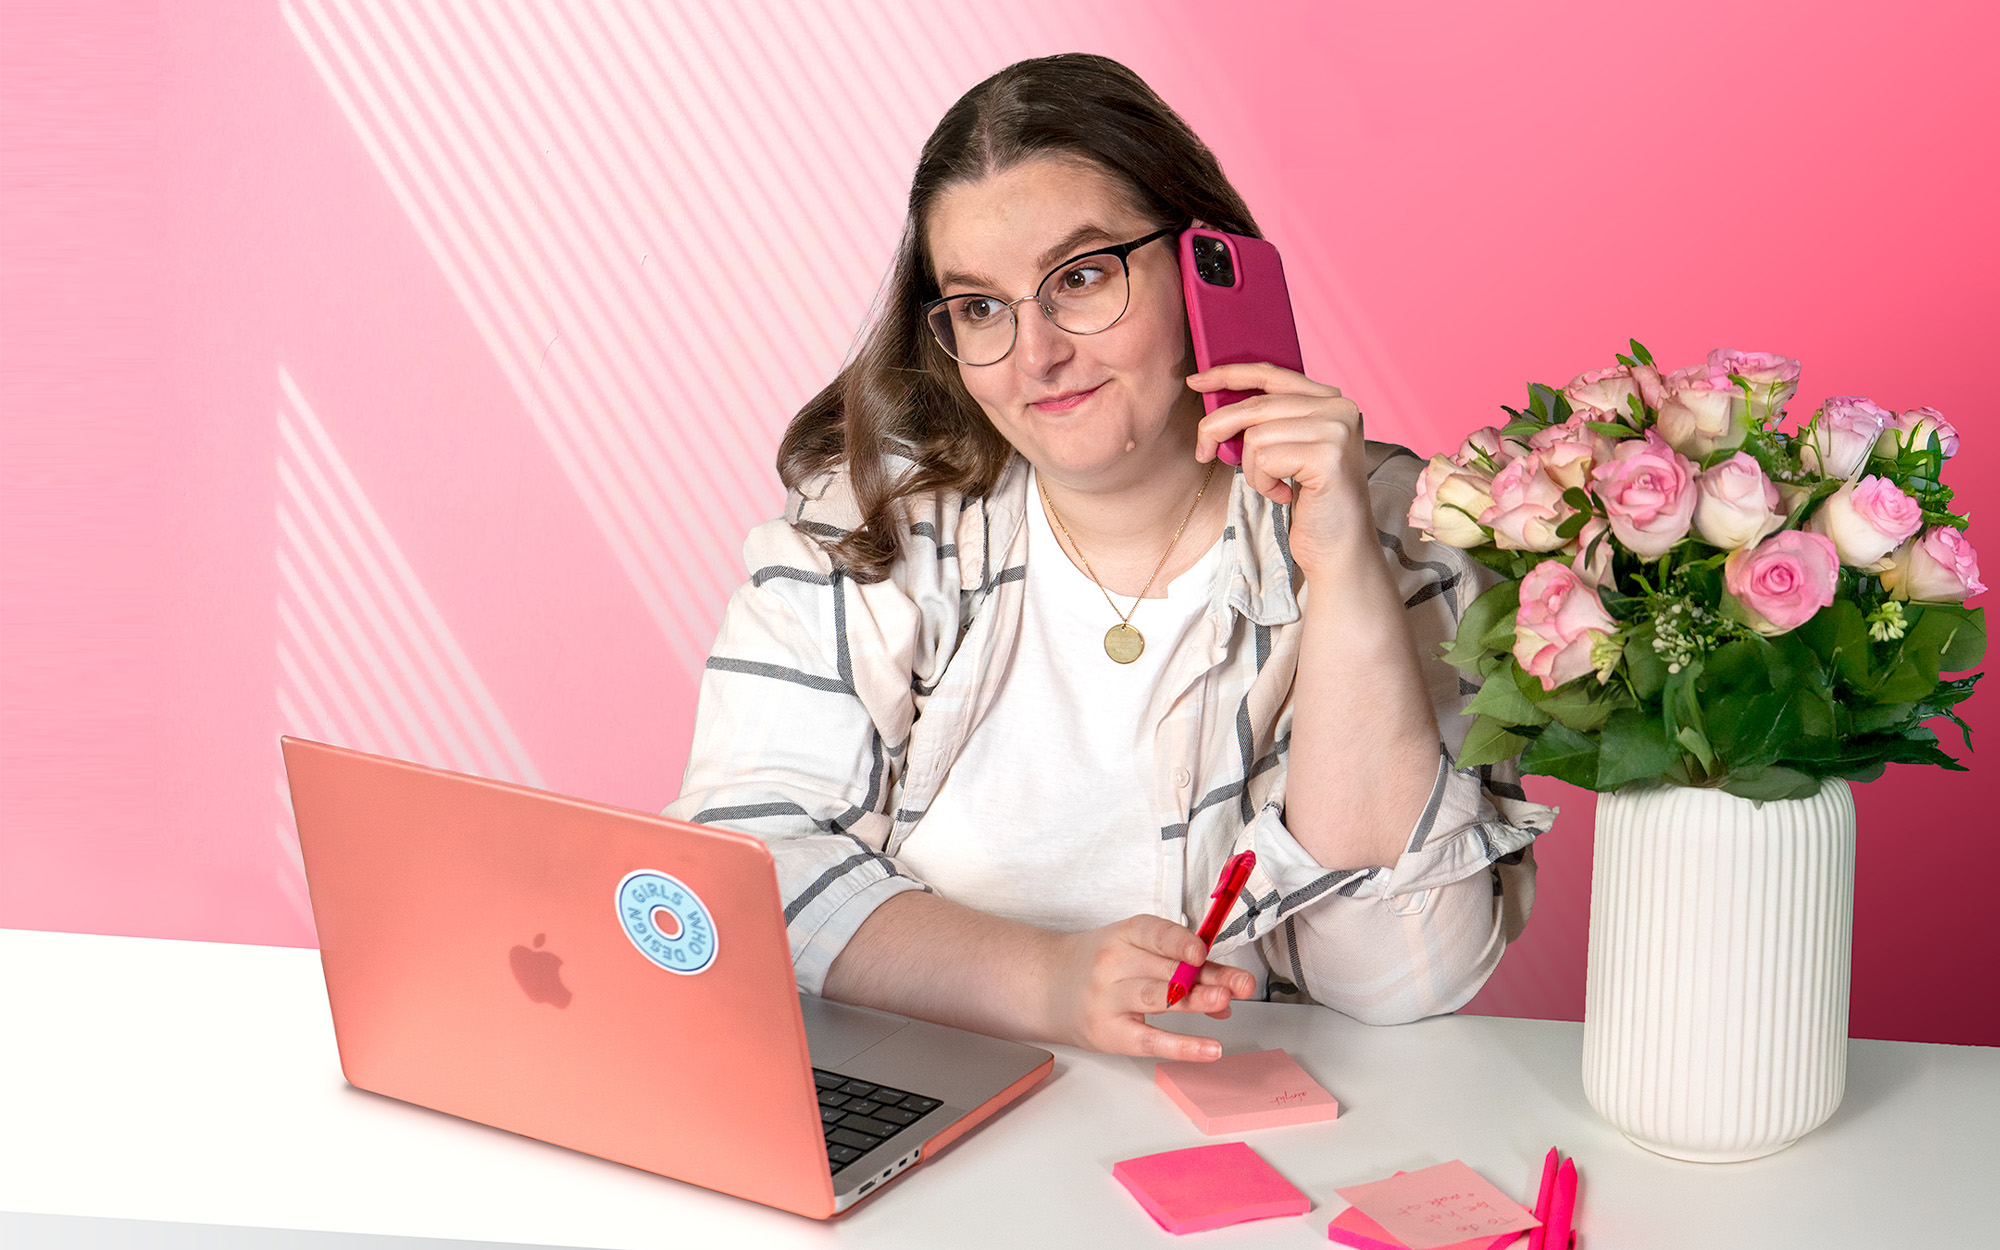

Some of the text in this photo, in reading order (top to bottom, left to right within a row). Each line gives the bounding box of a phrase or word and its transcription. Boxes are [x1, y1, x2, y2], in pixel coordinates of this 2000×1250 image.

[627, 882, 707, 963] GIRLS WHO DESIGN
